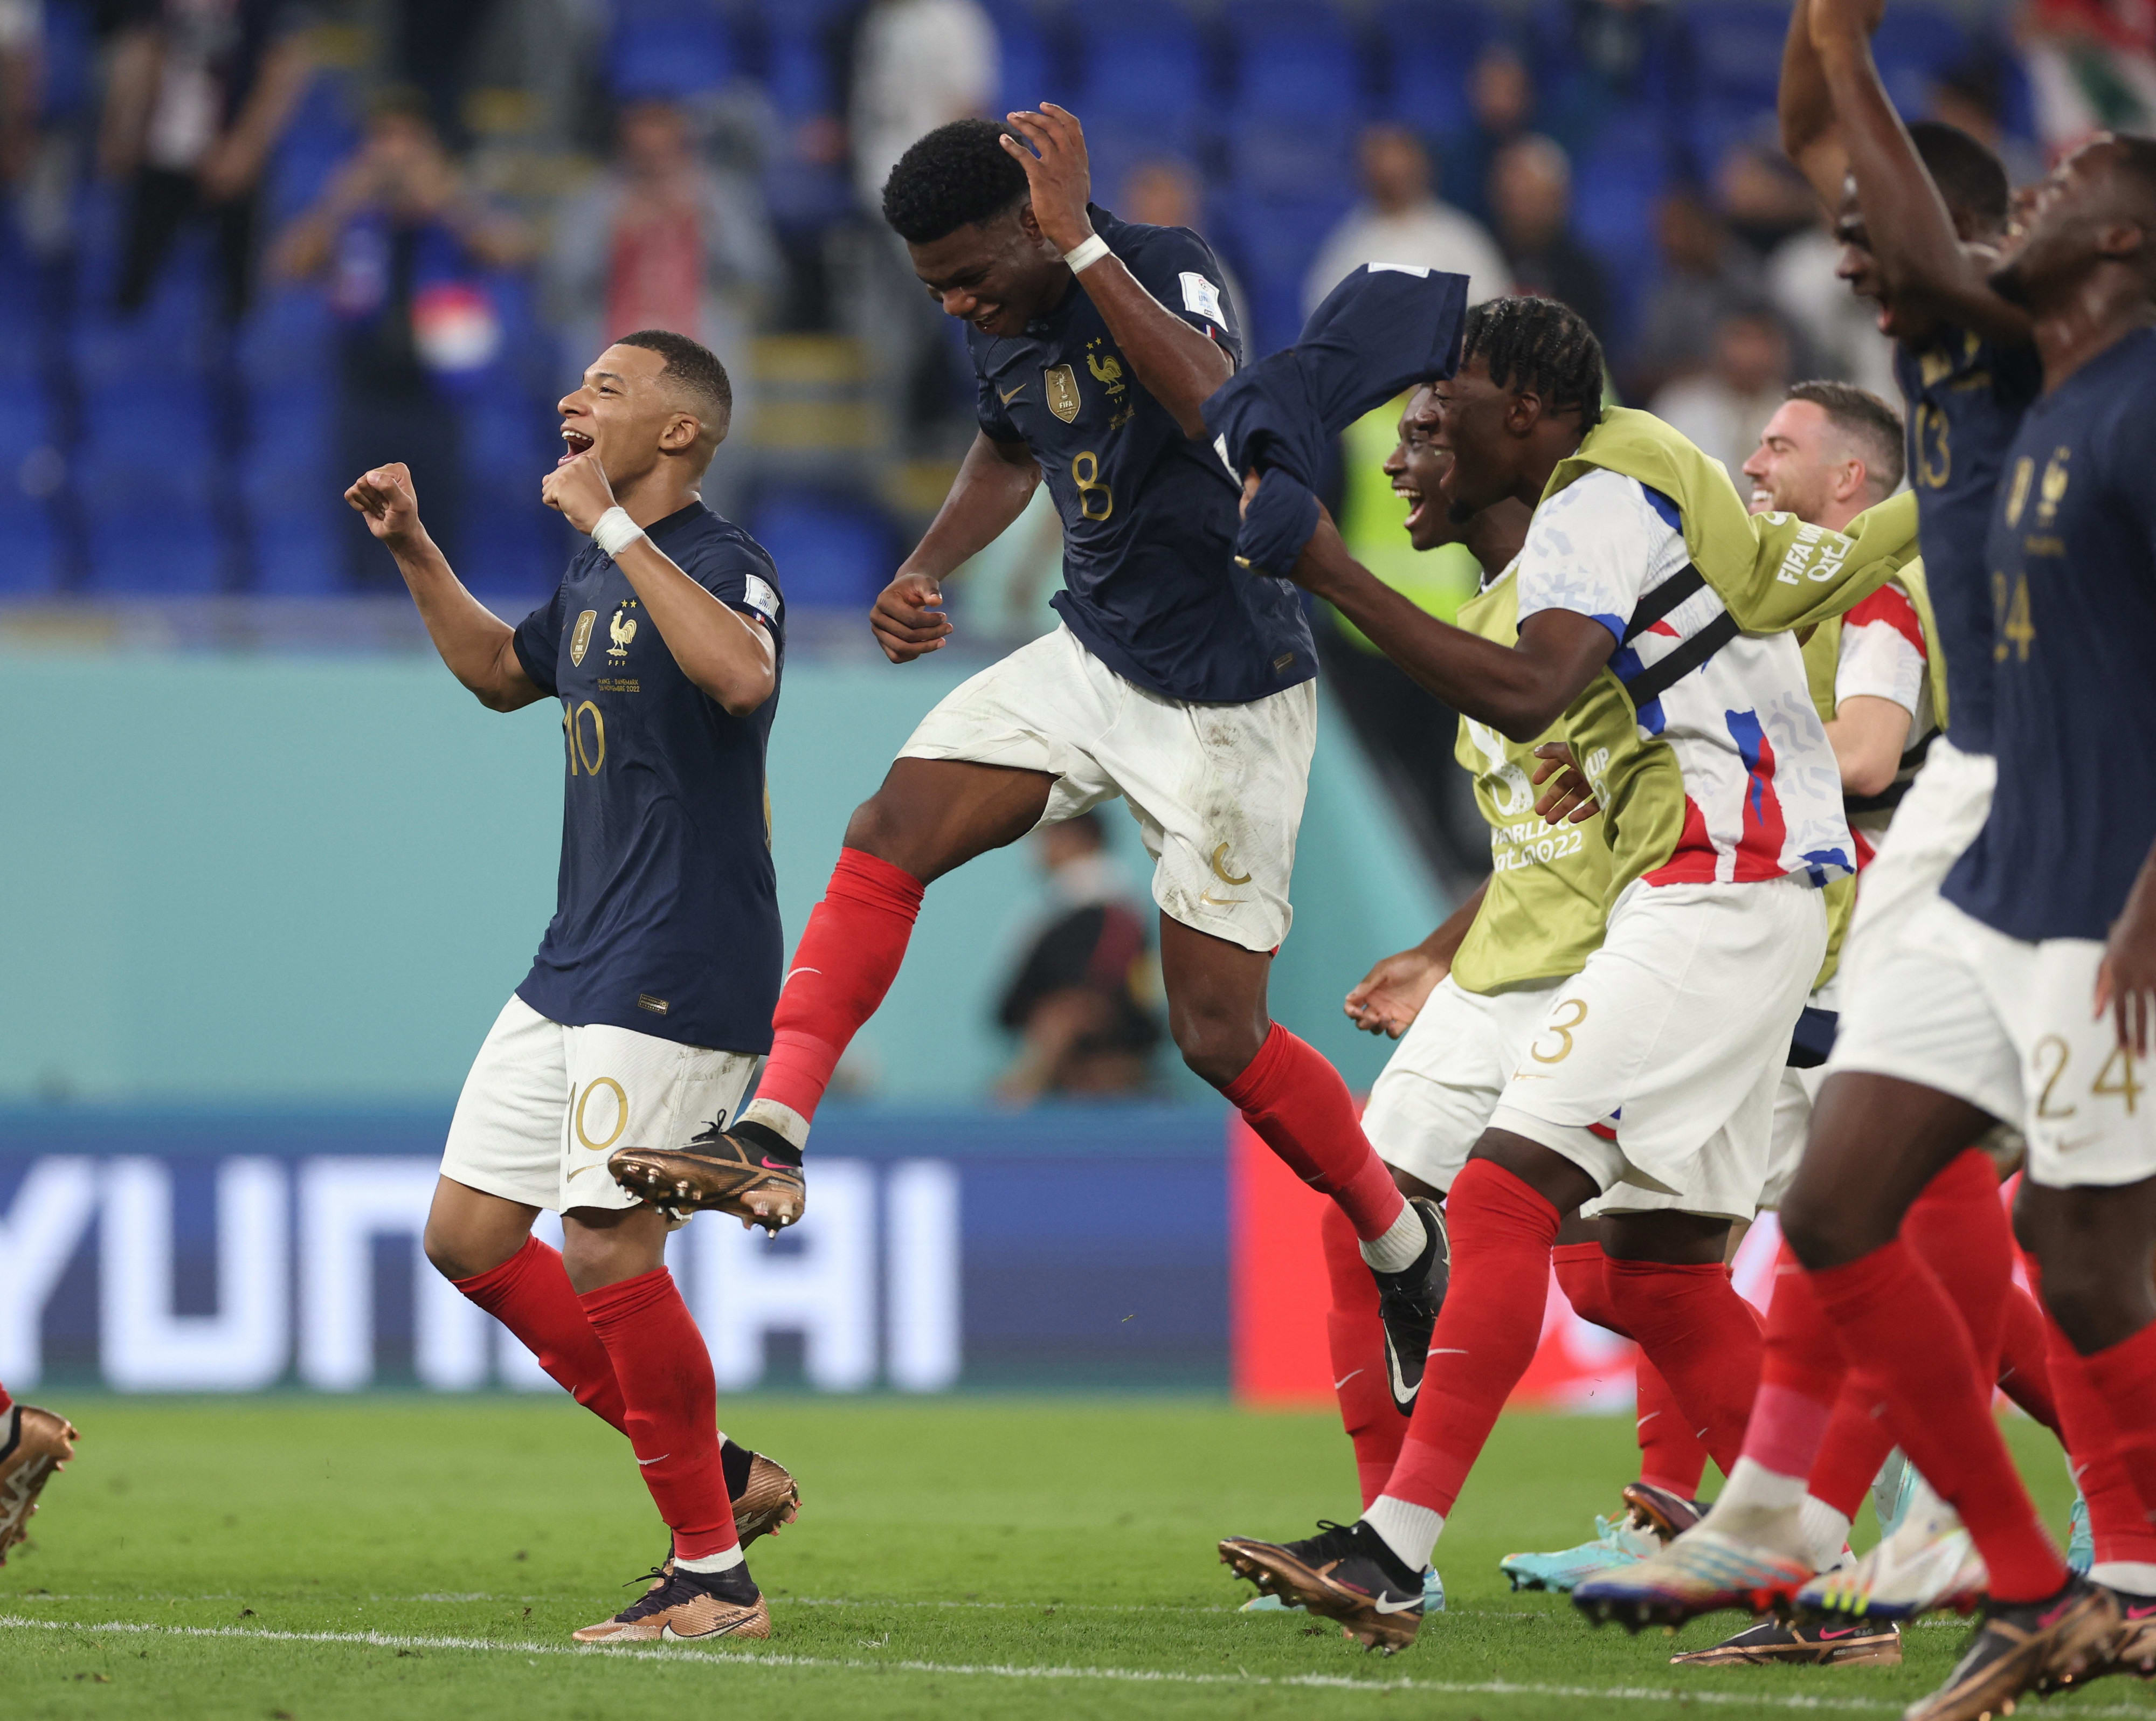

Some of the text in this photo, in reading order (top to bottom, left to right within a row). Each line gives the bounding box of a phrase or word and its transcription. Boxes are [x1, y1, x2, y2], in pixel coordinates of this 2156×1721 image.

[1059, 400, 1073, 409] FIFA
[1072, 451, 1113, 521] 8
[1777, 543, 1814, 585] FIFA
[563, 700, 605, 776] 10
[1531, 999, 1588, 1064] 3
[2033, 1034, 2145, 1117] 24
[567, 1077, 628, 1155] 10
